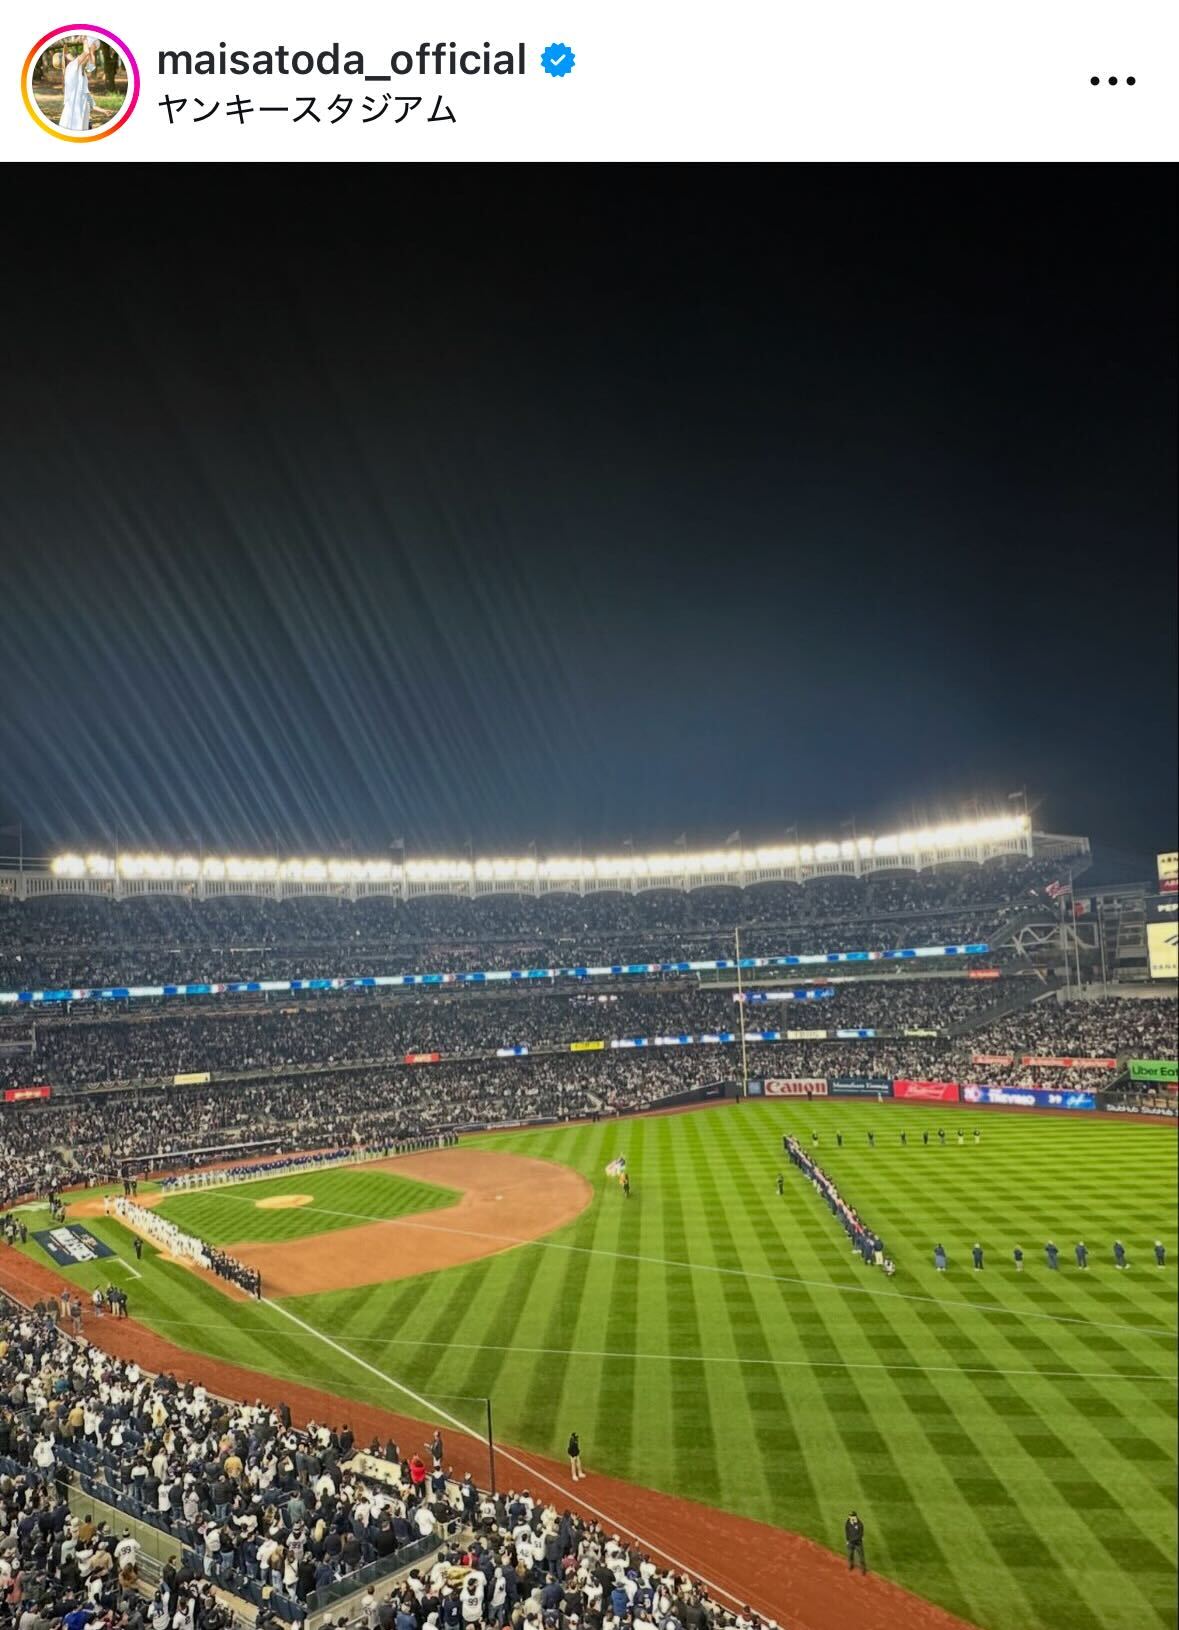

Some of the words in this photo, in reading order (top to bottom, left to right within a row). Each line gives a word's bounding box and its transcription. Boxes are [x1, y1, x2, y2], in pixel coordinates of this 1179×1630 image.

[1132, 1065, 1158, 1075] Uber
[766, 1081, 827, 1094] Canon
[120, 1545, 132, 1555] 99
[468, 1597, 478, 1606] 99
